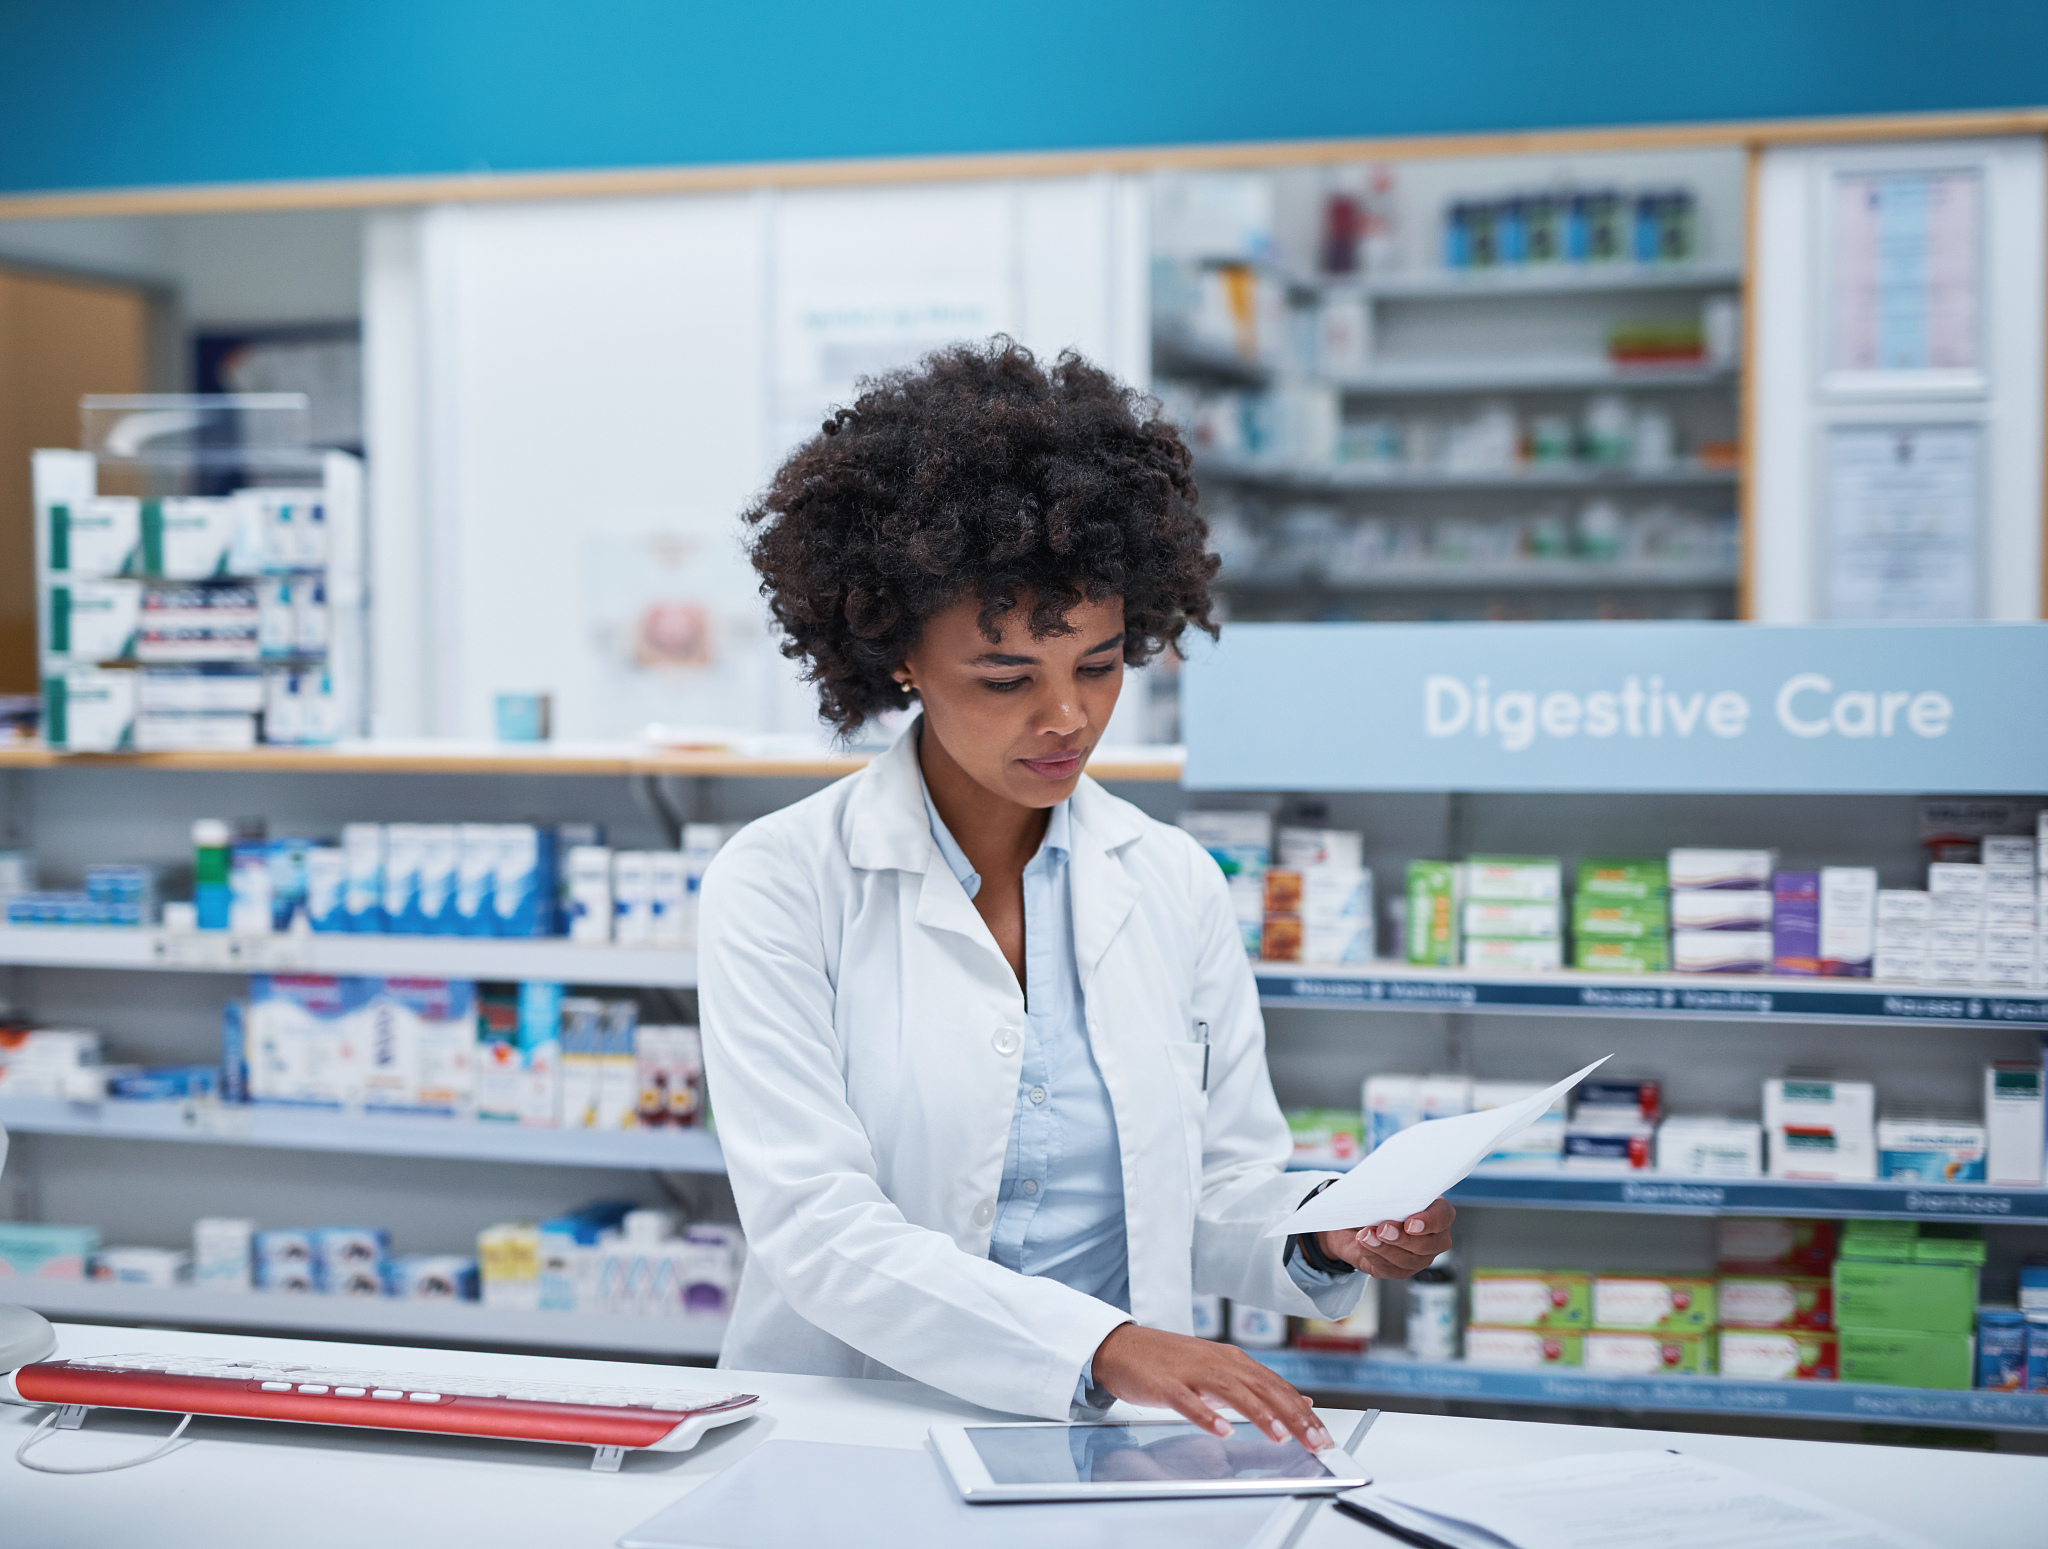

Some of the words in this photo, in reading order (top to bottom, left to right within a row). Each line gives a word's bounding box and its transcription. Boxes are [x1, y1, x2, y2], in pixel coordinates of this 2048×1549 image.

[1424, 674, 1750, 752] Digestive
[1775, 673, 1953, 738] Care
[1293, 979, 1366, 998] Nausea
[1390, 982, 1477, 1007] Vomiting
[1580, 986, 1658, 1008] Nausea
[1682, 989, 1773, 1014] Vomiting
[1884, 994, 1965, 1018] Nausea
